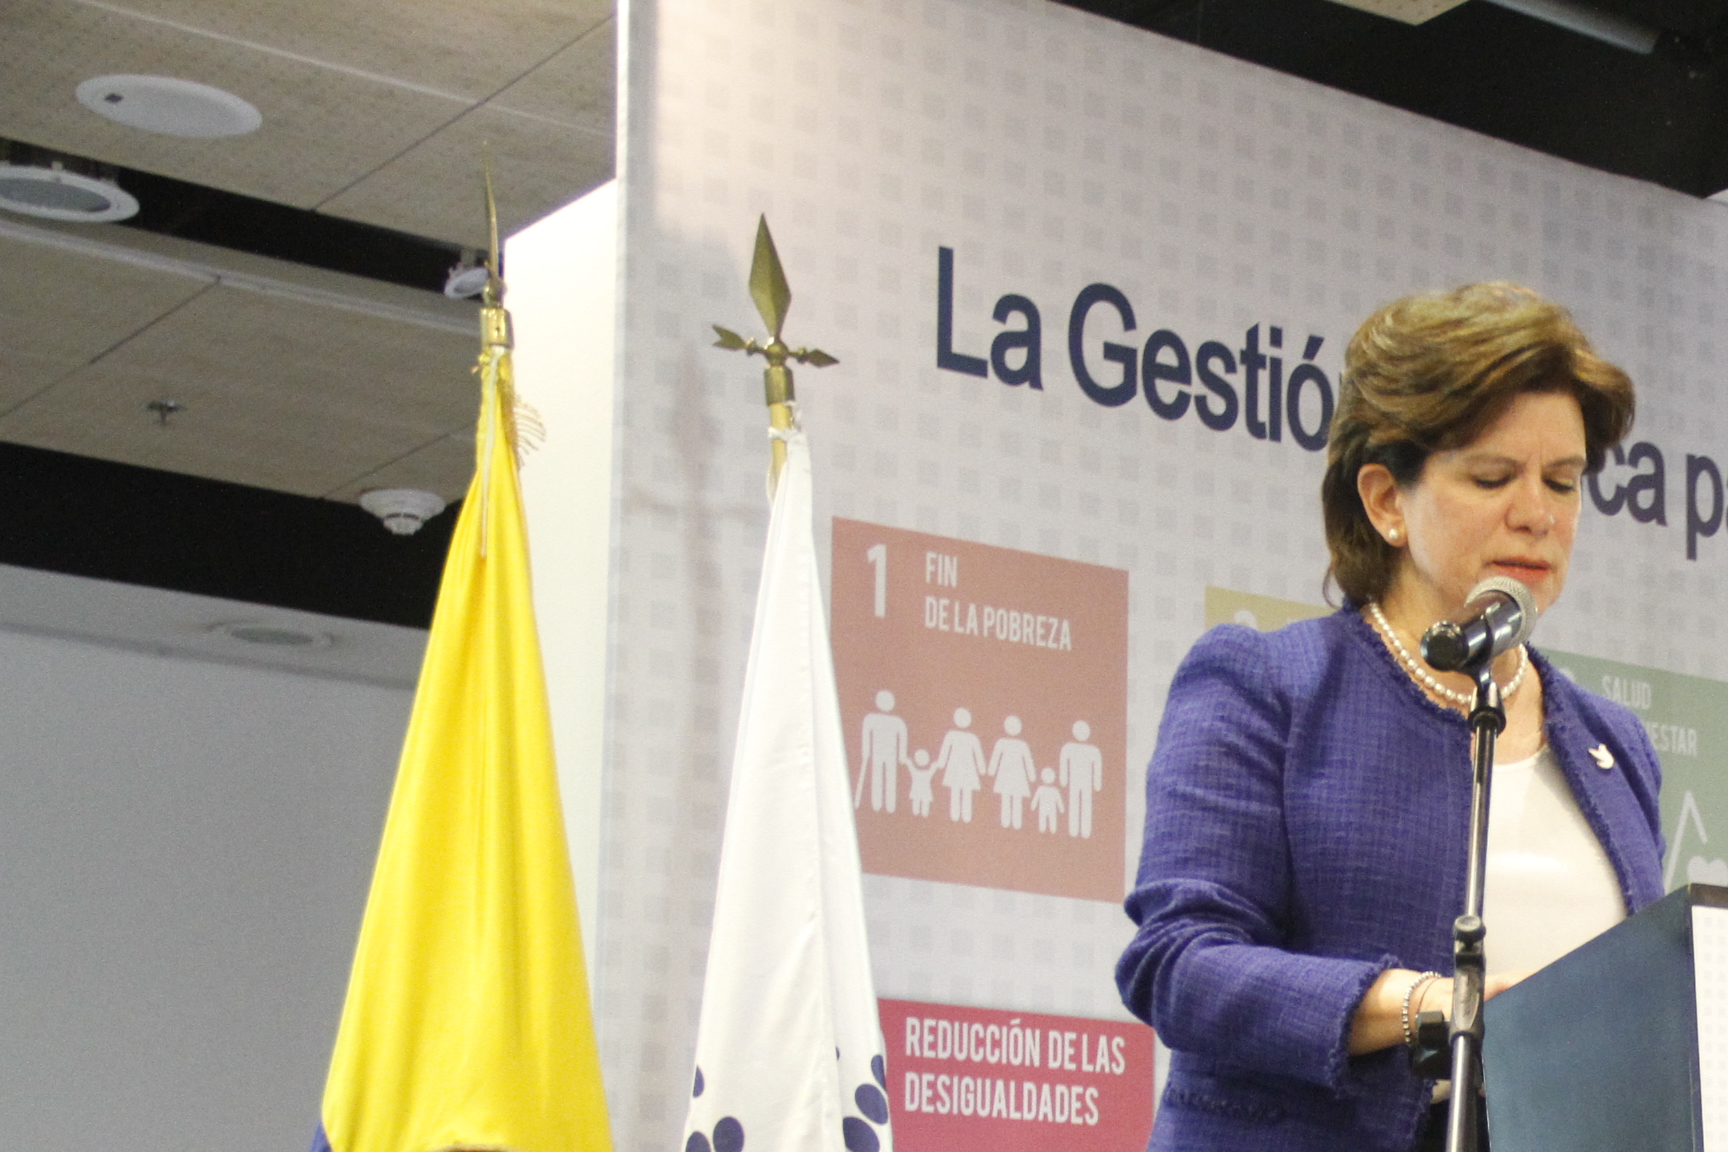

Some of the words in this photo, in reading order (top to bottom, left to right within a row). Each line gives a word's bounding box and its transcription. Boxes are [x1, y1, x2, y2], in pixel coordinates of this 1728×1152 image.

[936, 246, 1043, 391] La
[1069, 283, 1340, 451] Gestió
[867, 543, 887, 618] 1
[926, 551, 958, 588] FIN
[925, 596, 949, 631] DE
[954, 601, 978, 636] LA
[983, 606, 1072, 651] POBREZA
[905, 1018, 1041, 1067] REDUCCIÓN
[1047, 1029, 1077, 1070] DE
[1081, 1033, 1125, 1075] LAS
[904, 1071, 1099, 1126] DESIGUALDADES
